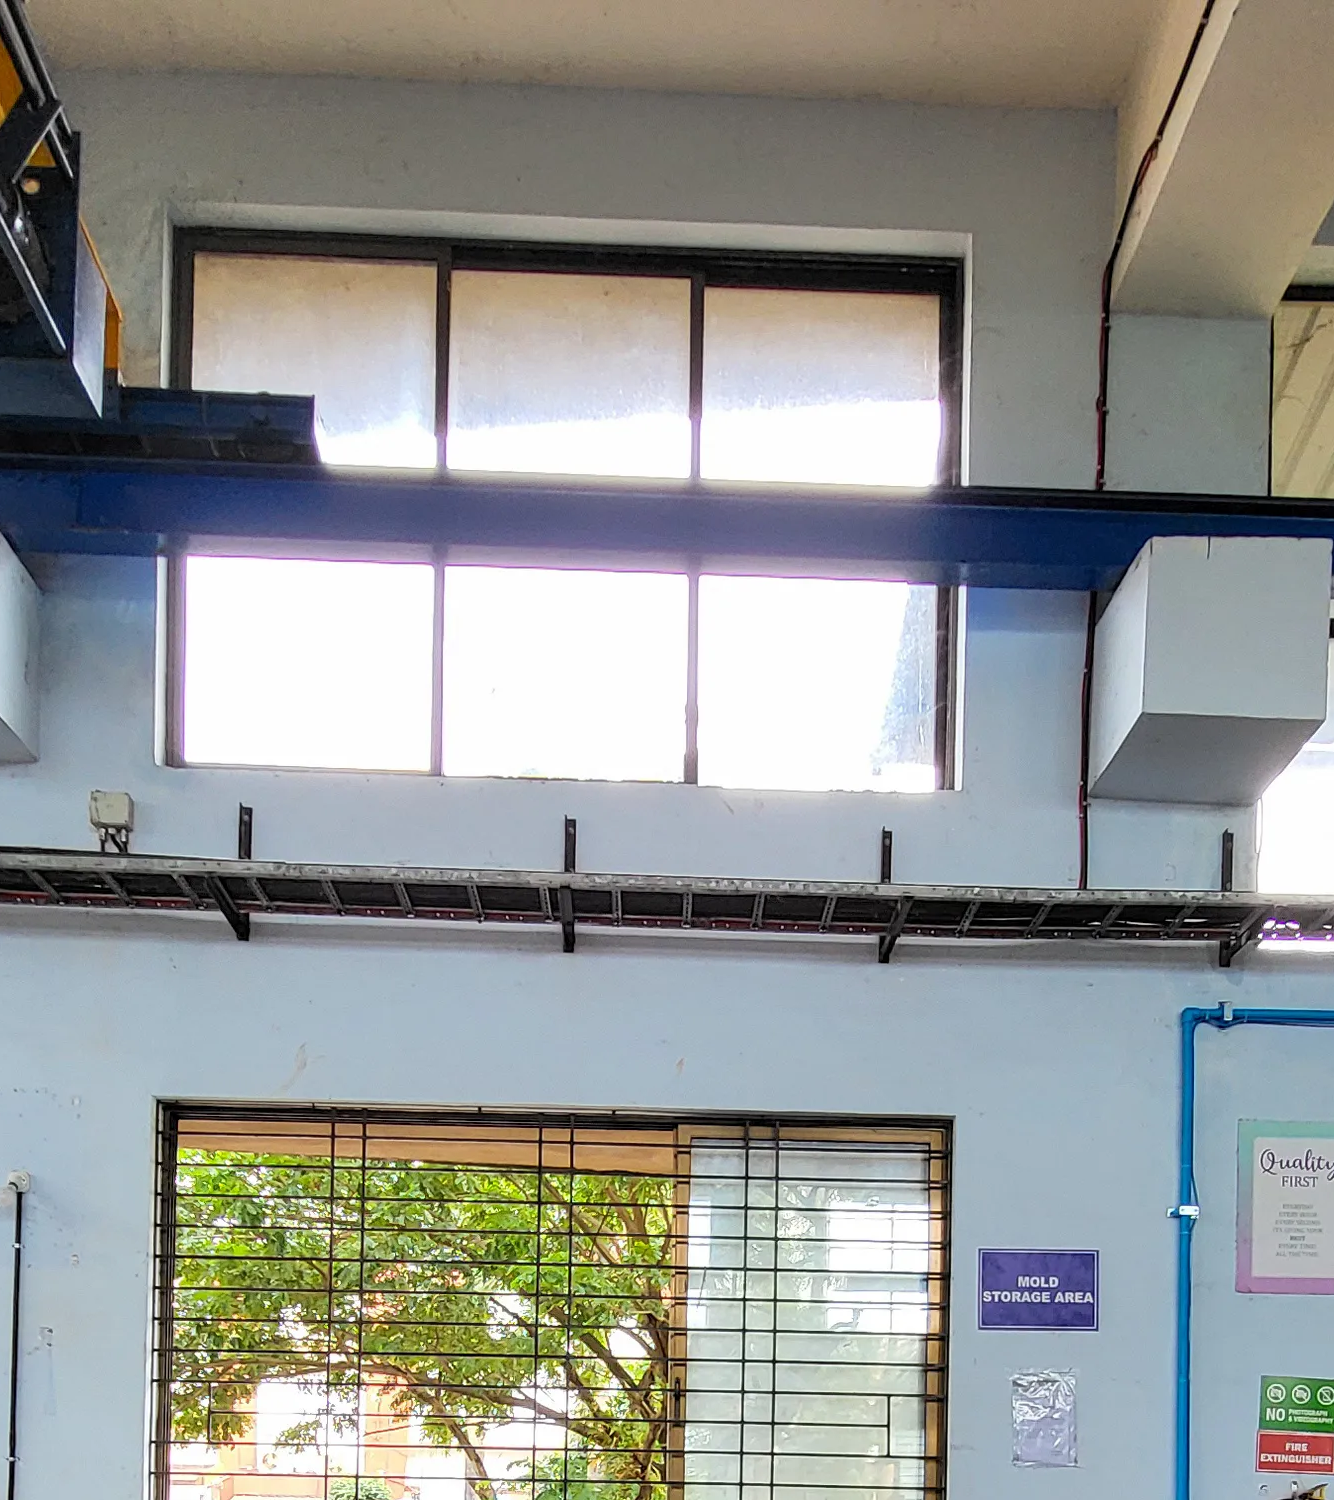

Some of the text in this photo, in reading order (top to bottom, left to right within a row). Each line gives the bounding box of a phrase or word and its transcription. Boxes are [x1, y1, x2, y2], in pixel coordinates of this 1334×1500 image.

[1281, 1175, 1319, 1188] FIRST
[1017, 1275, 1059, 1288] MOLD
[982, 1290, 1094, 1304] STORAGE AREA
[1265, 1407, 1286, 1421] NO
[1285, 1442, 1309, 1452] FIRE
[1260, 1452, 1332, 1464] EXTINGUISHER
